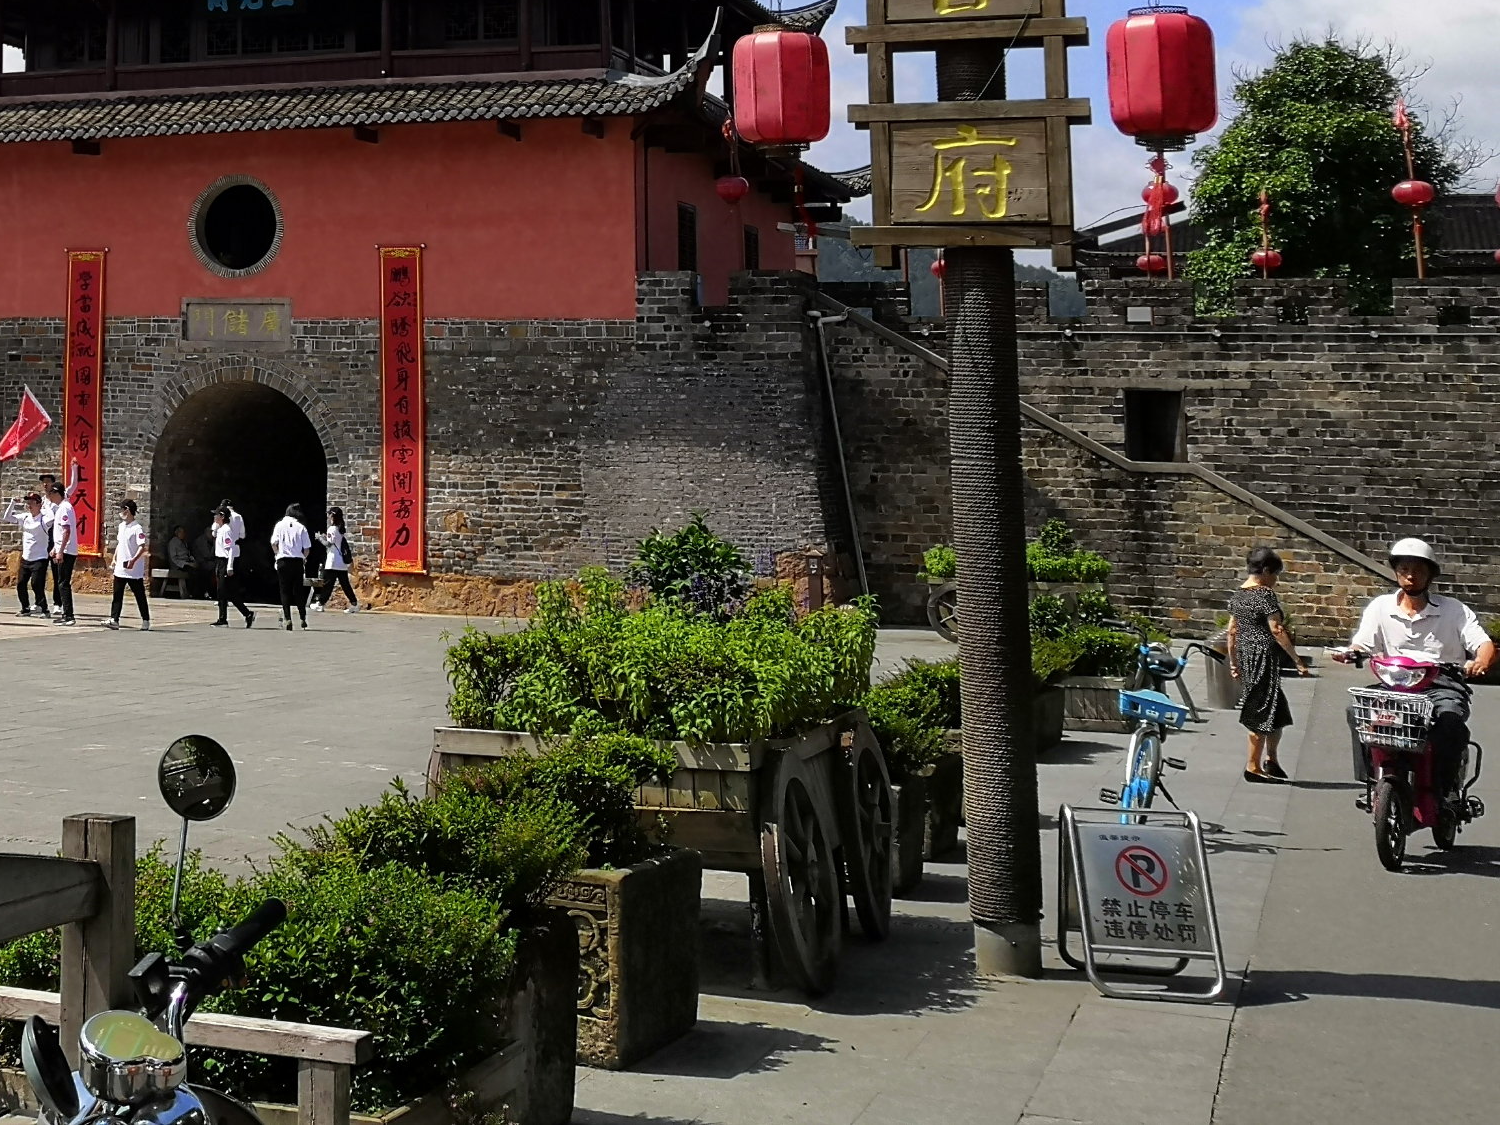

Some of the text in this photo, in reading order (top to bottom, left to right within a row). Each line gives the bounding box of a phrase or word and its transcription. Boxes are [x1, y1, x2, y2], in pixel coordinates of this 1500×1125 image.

[1101, 898, 1194, 921] 禁止停车
[1103, 919, 1197, 945] 违停处罚
